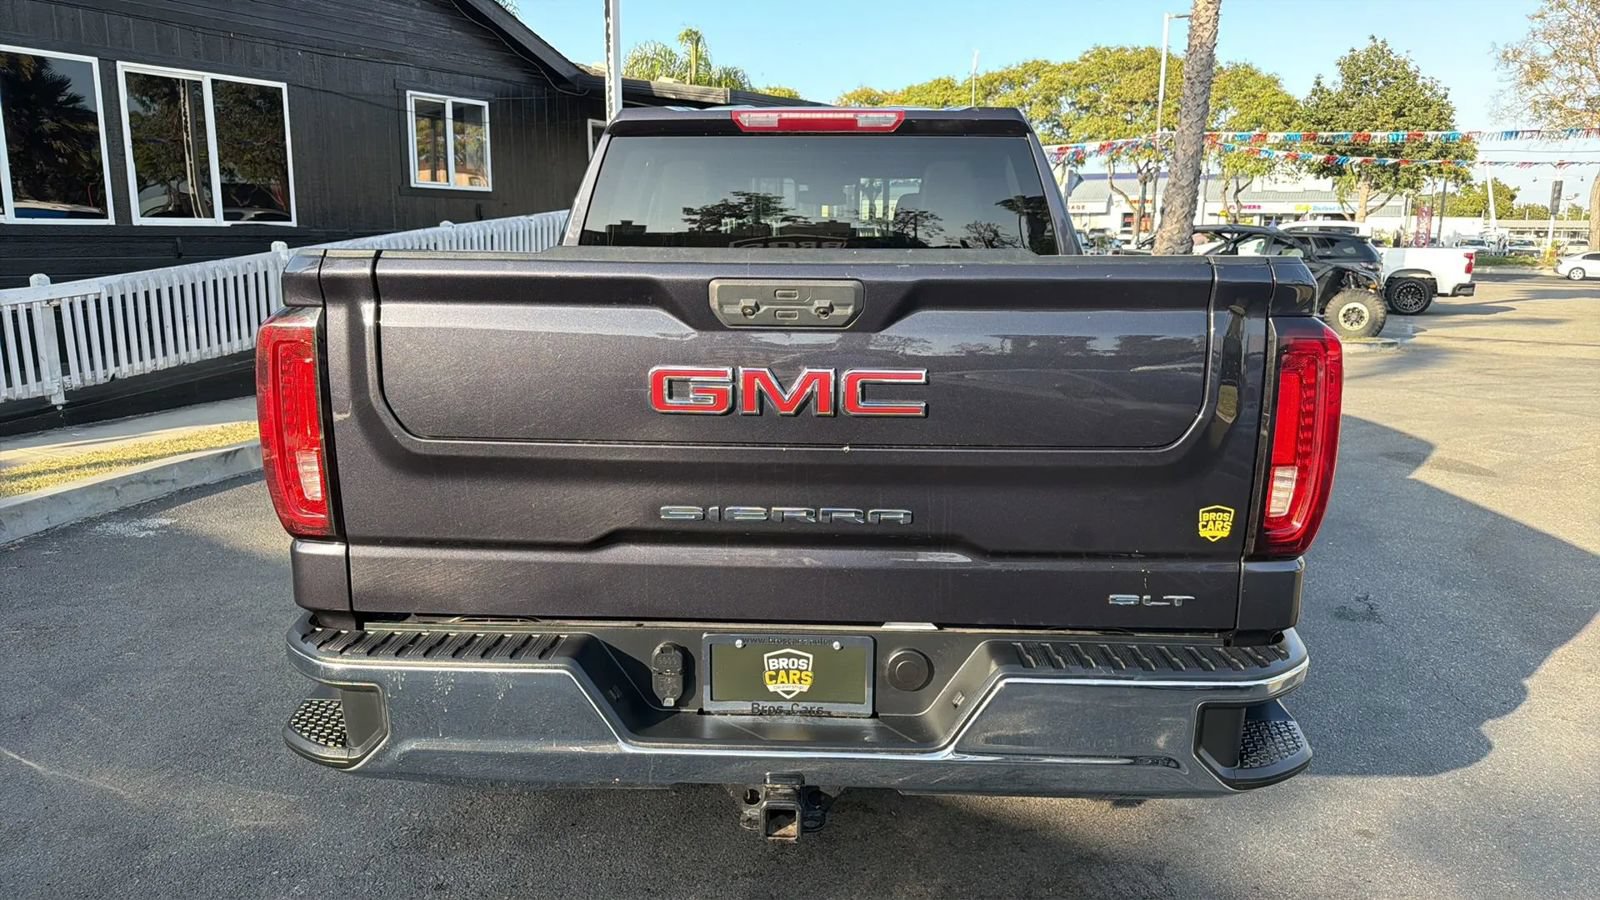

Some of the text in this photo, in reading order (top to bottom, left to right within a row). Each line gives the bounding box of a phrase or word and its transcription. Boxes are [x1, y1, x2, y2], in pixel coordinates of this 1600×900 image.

[648, 366, 928, 417] GMC
[660, 506, 913, 525] SIERRA
[1202, 512, 1231, 522] BROS
[1199, 521, 1232, 532] CARS
[1109, 594, 1196, 607] SLT
[768, 658, 809, 670] BROS
[764, 669, 814, 685] CARS
[751, 702, 825, 716] Bros Cars
